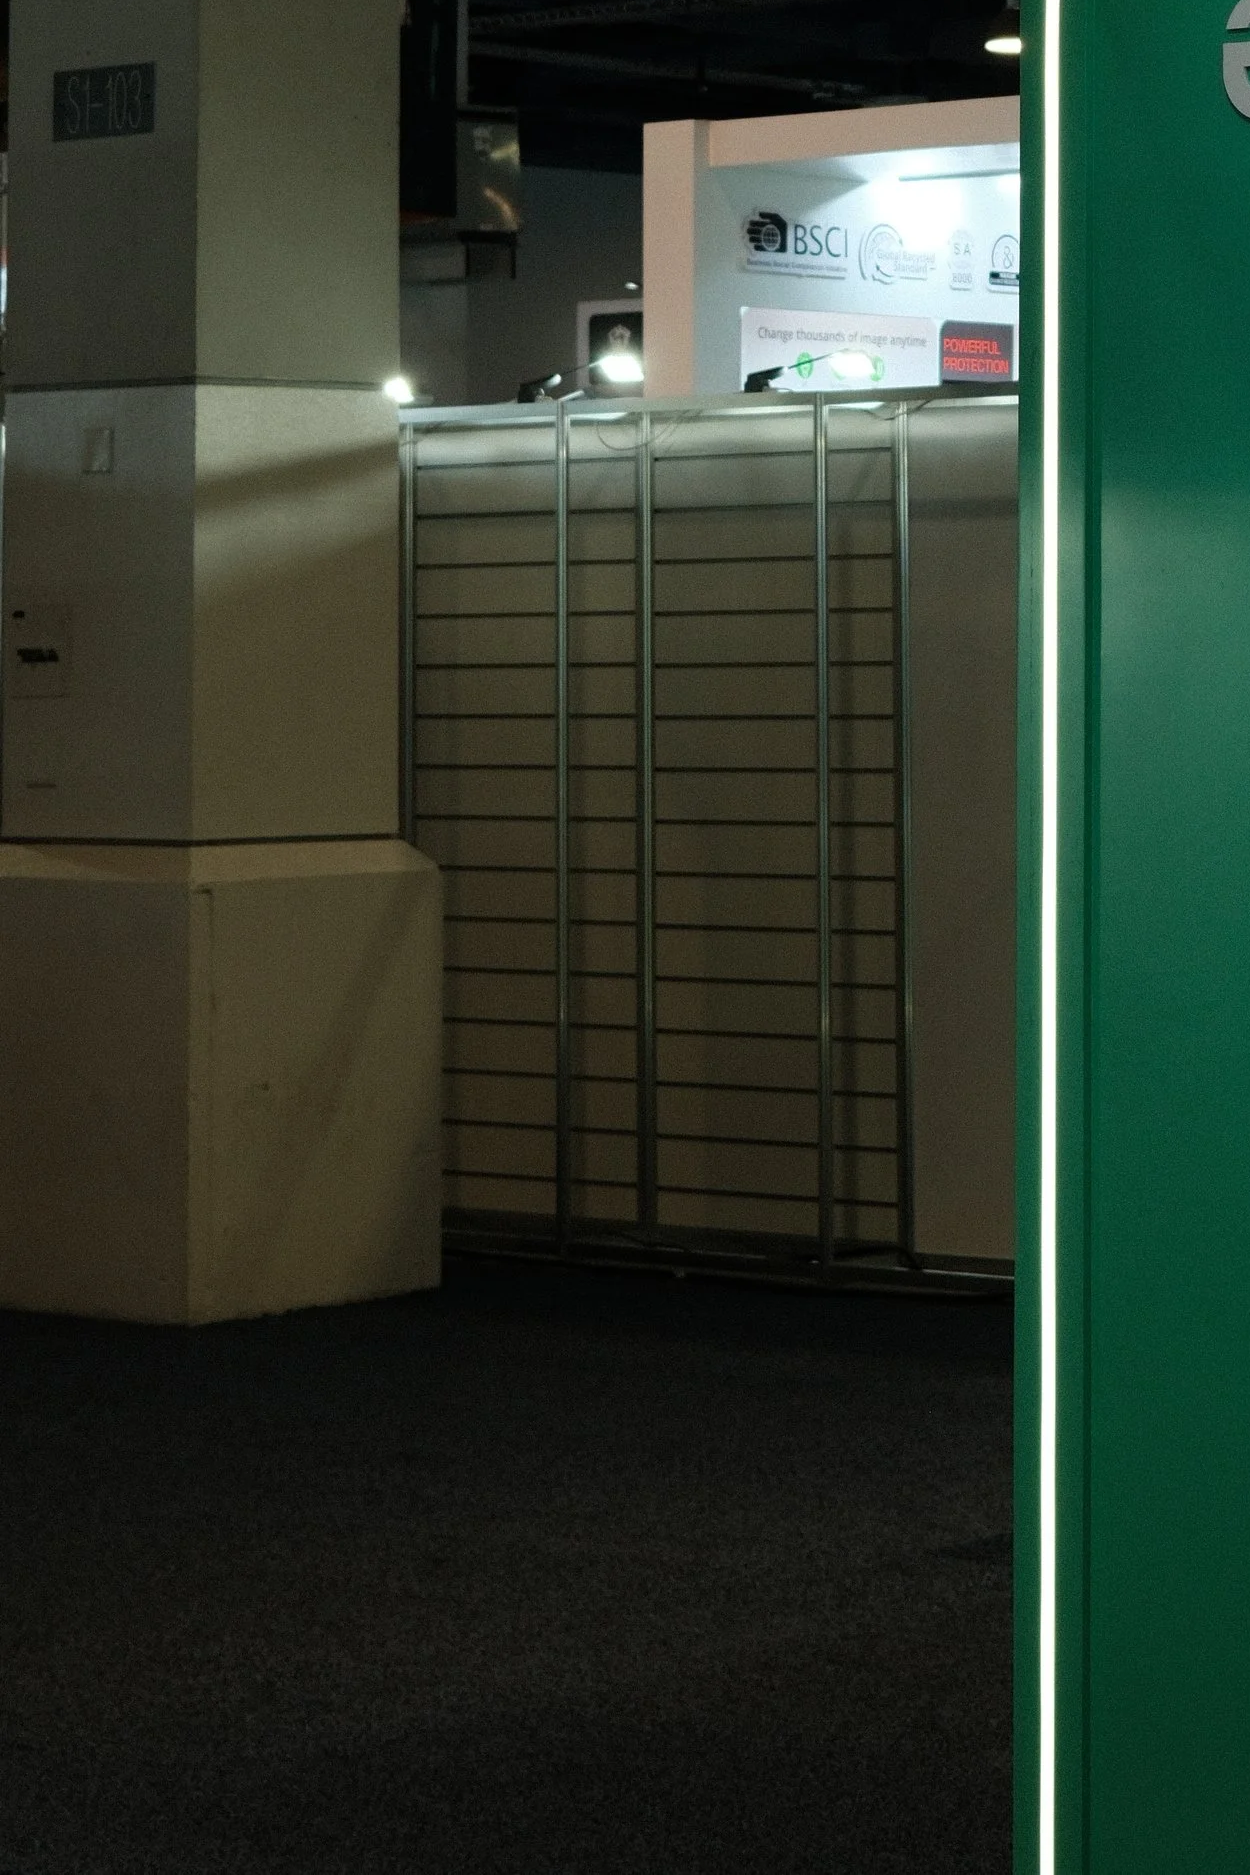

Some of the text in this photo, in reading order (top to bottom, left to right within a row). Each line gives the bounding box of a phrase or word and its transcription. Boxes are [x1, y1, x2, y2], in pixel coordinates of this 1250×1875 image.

[794, 223, 848, 258] BSCI
[758, 326, 927, 349] Change thousands of image anytime
[943, 338, 1001, 355] POWERFUL
[943, 357, 1010, 375] PROTECTION
